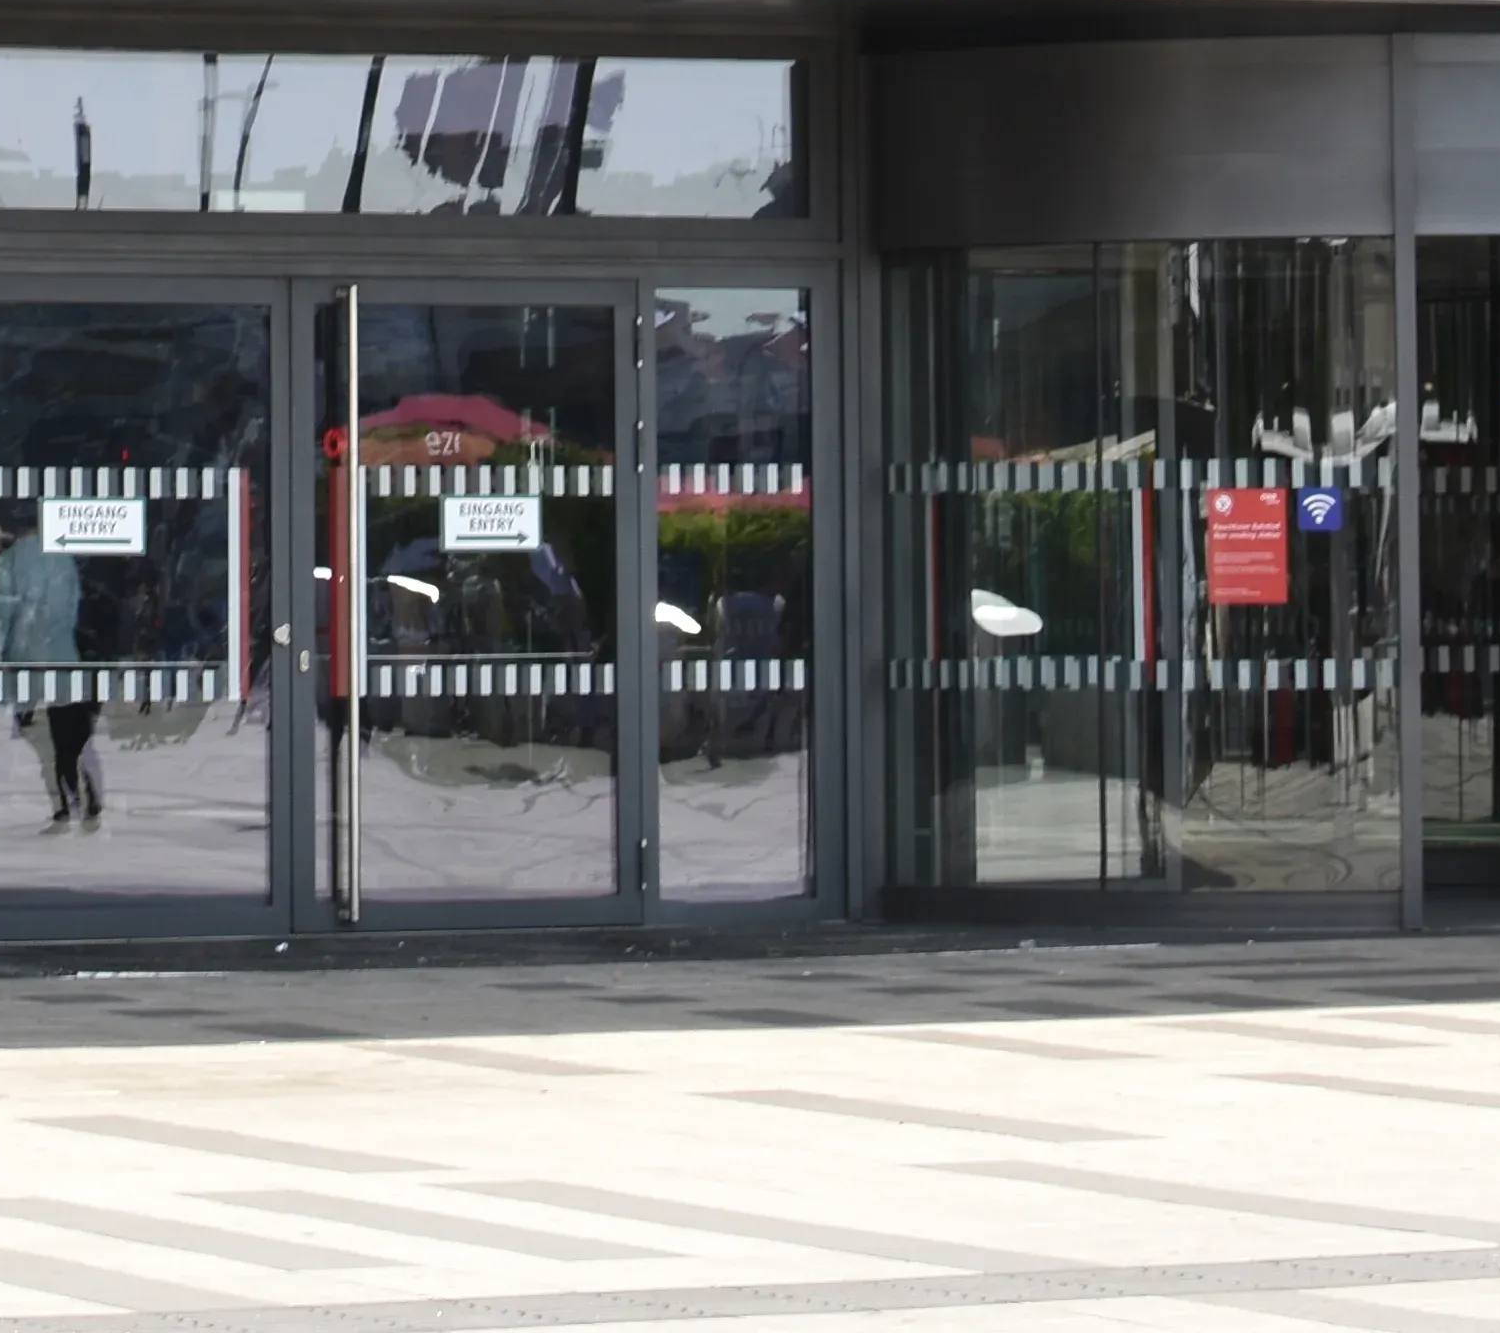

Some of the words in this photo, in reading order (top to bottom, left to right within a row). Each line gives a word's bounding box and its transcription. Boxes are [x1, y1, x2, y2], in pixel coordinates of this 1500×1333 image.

[58, 505, 128, 520] EINGANG
[458, 501, 525, 517] EINGANG
[69, 520, 117, 534] ENTRY
[469, 517, 515, 532] ENTRY
